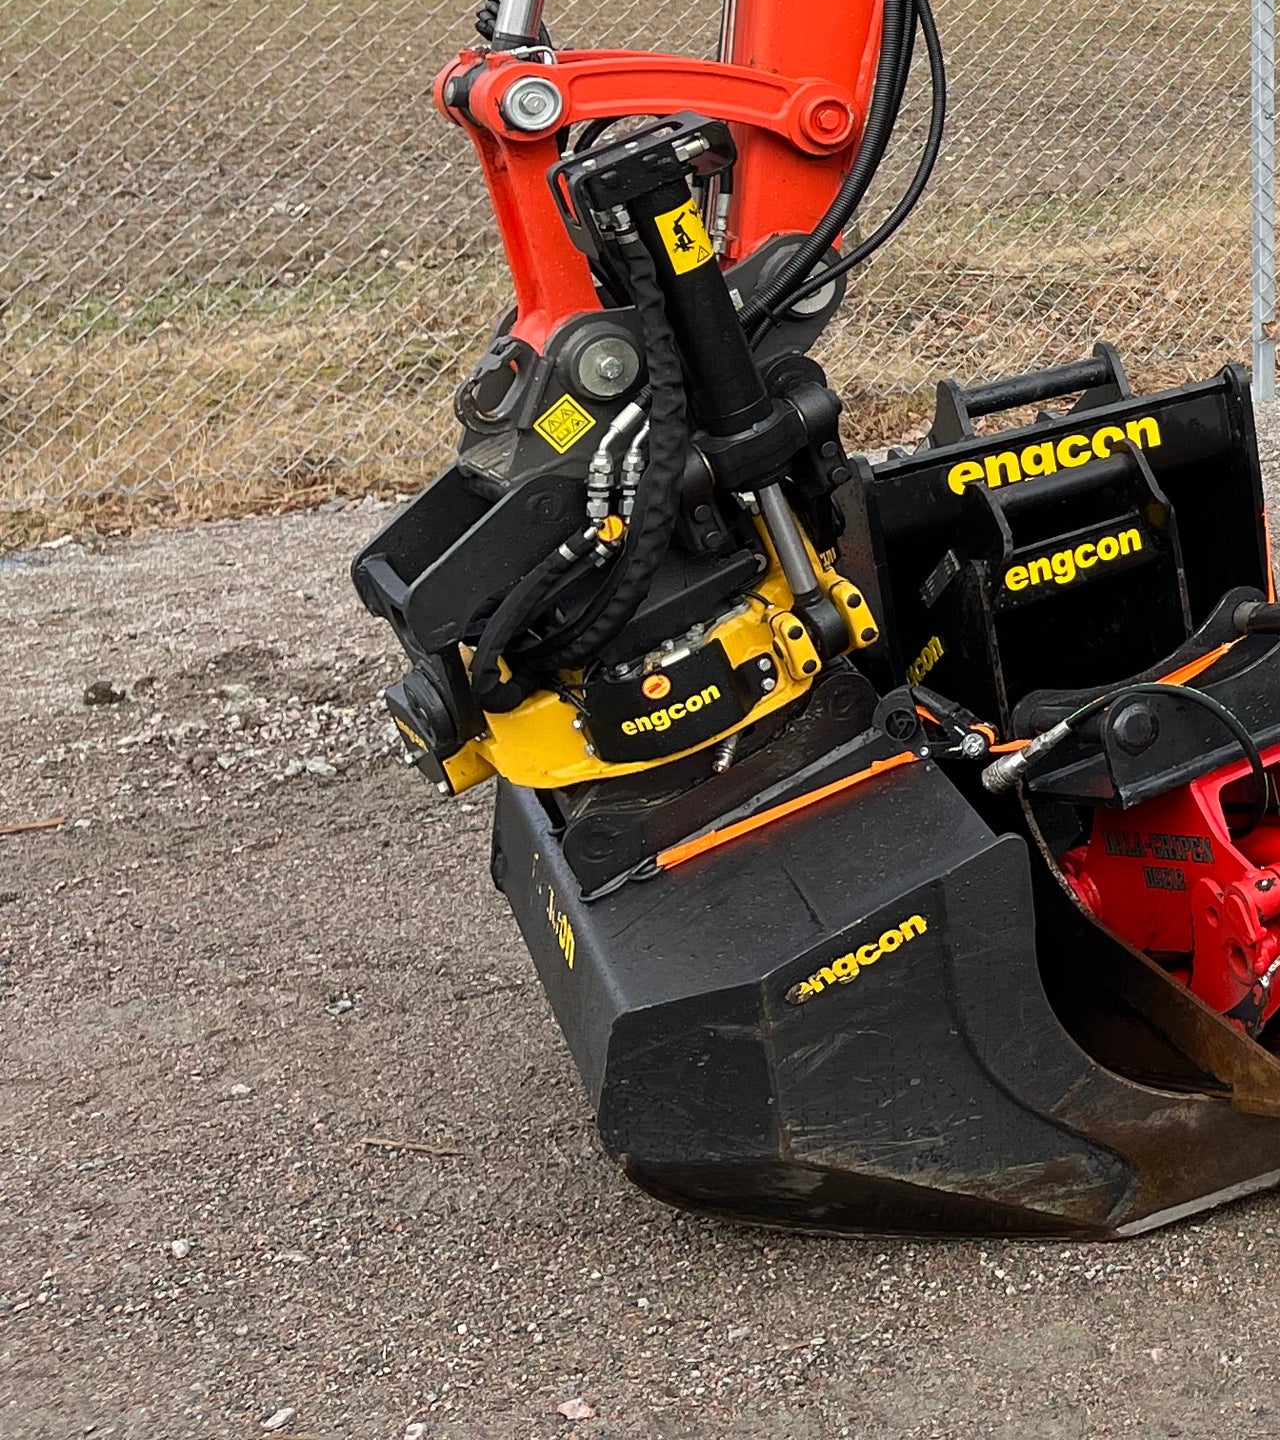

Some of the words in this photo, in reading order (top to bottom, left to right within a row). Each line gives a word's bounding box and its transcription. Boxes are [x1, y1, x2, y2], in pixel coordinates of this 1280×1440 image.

[1004, 528, 1143, 592] engcon
[621, 683, 721, 736] engcon
[785, 914, 928, 1005] engcon
